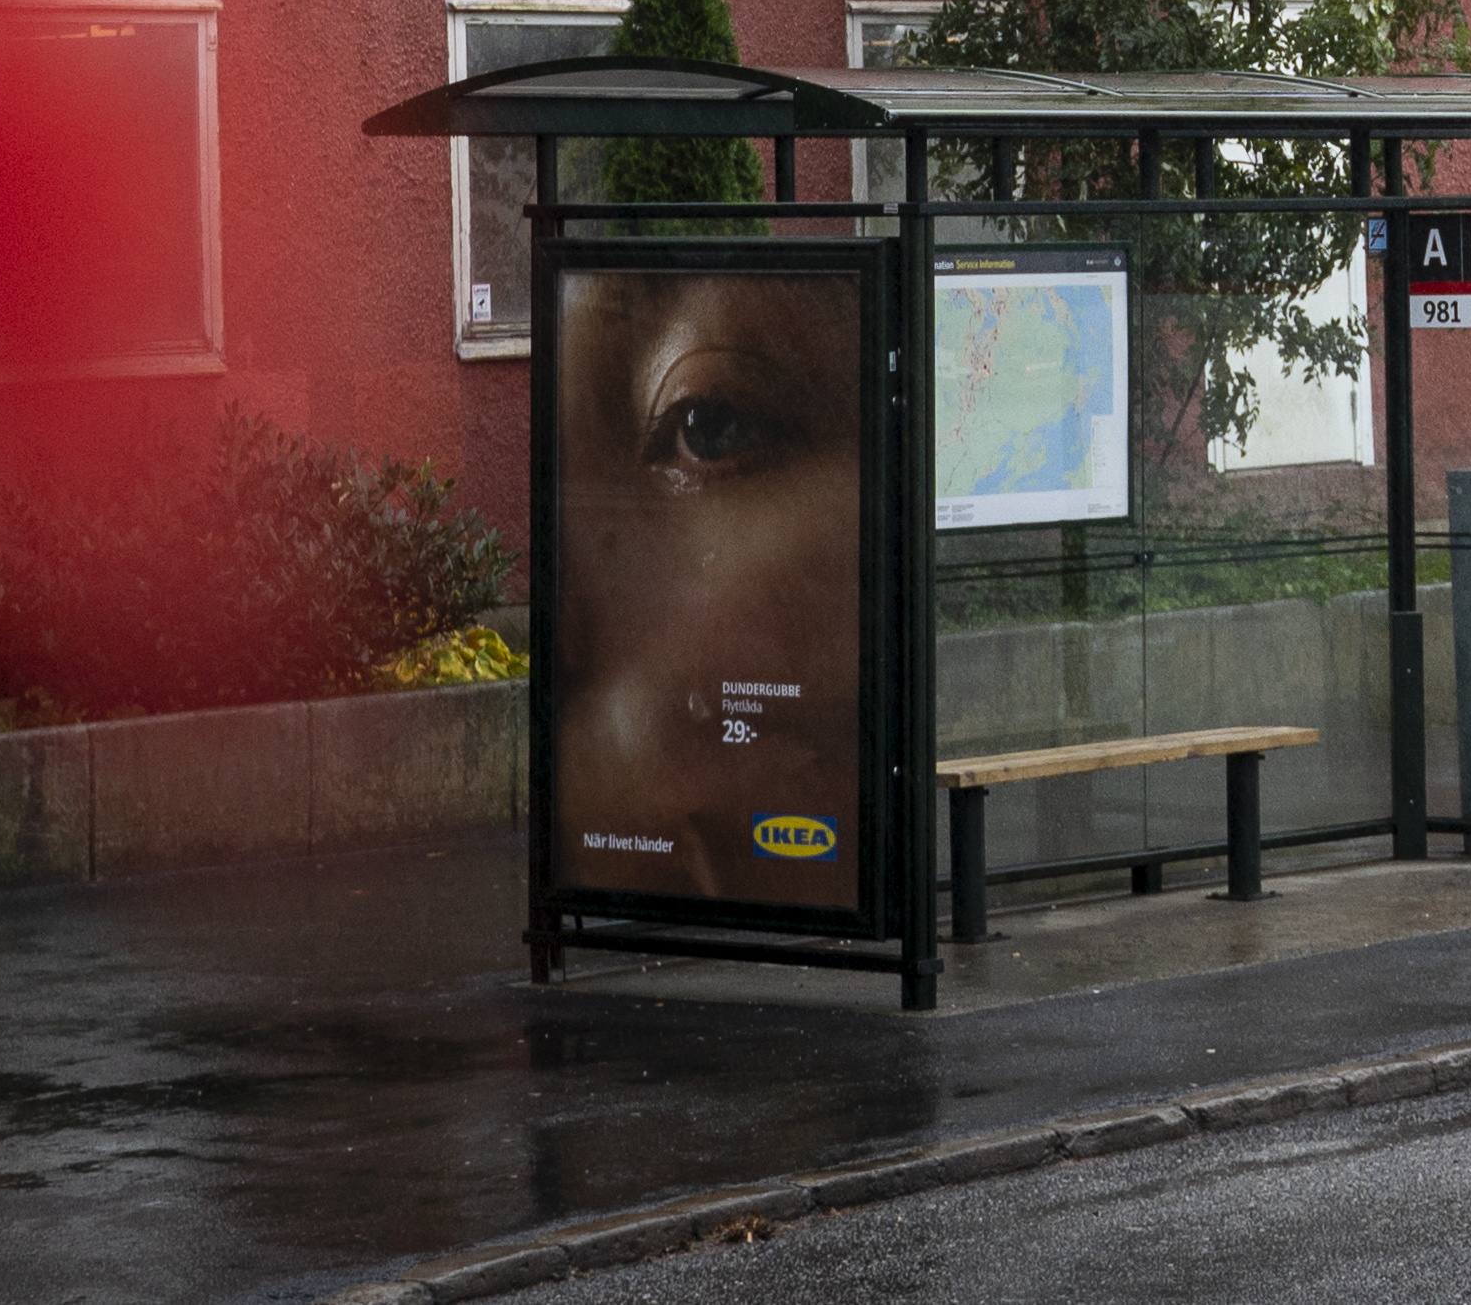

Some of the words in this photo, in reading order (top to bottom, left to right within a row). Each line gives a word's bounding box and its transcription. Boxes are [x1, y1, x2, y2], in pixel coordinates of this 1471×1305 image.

[1423, 228, 1448, 266] A
[1423, 300, 1461, 324] 981
[722, 681, 801, 698] DUNDERGUBBE
[722, 698, 763, 715] Flyttlåda
[722, 719, 758, 743] 29:-
[584, 832, 607, 849] När
[609, 834, 633, 851] livet
[634, 836, 674, 853] händer
[760, 825, 830, 848] IKEA
